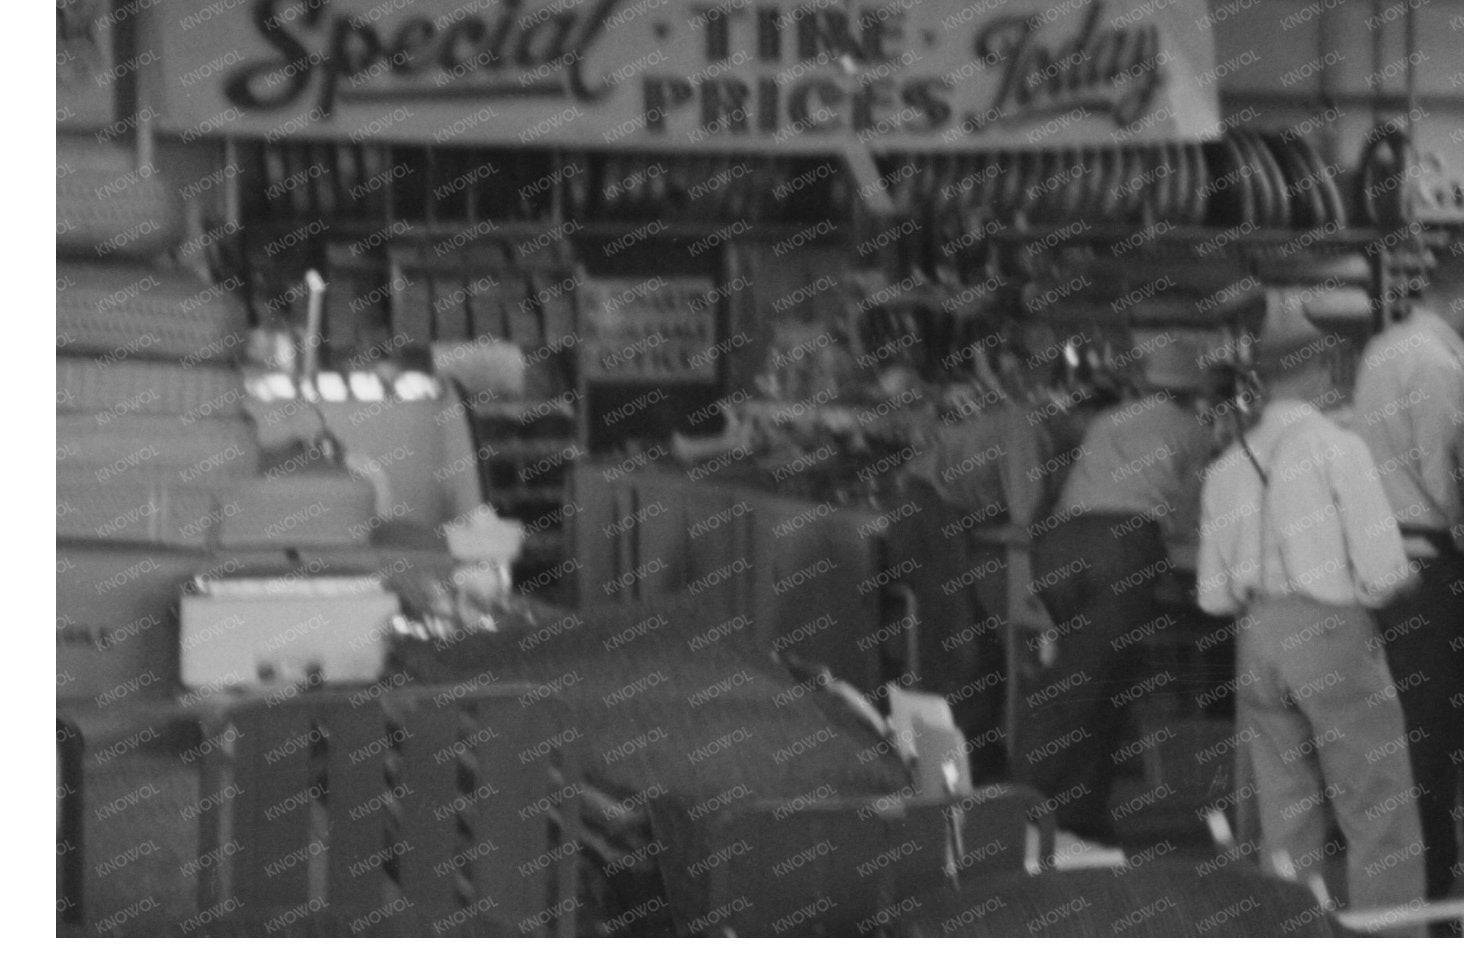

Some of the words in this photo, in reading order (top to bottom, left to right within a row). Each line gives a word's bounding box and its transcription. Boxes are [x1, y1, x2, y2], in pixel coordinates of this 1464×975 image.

[643, 75, 951, 135] PRICES
[690, 4, 906, 64] TIRE
[966, 0, 1163, 132] Today
